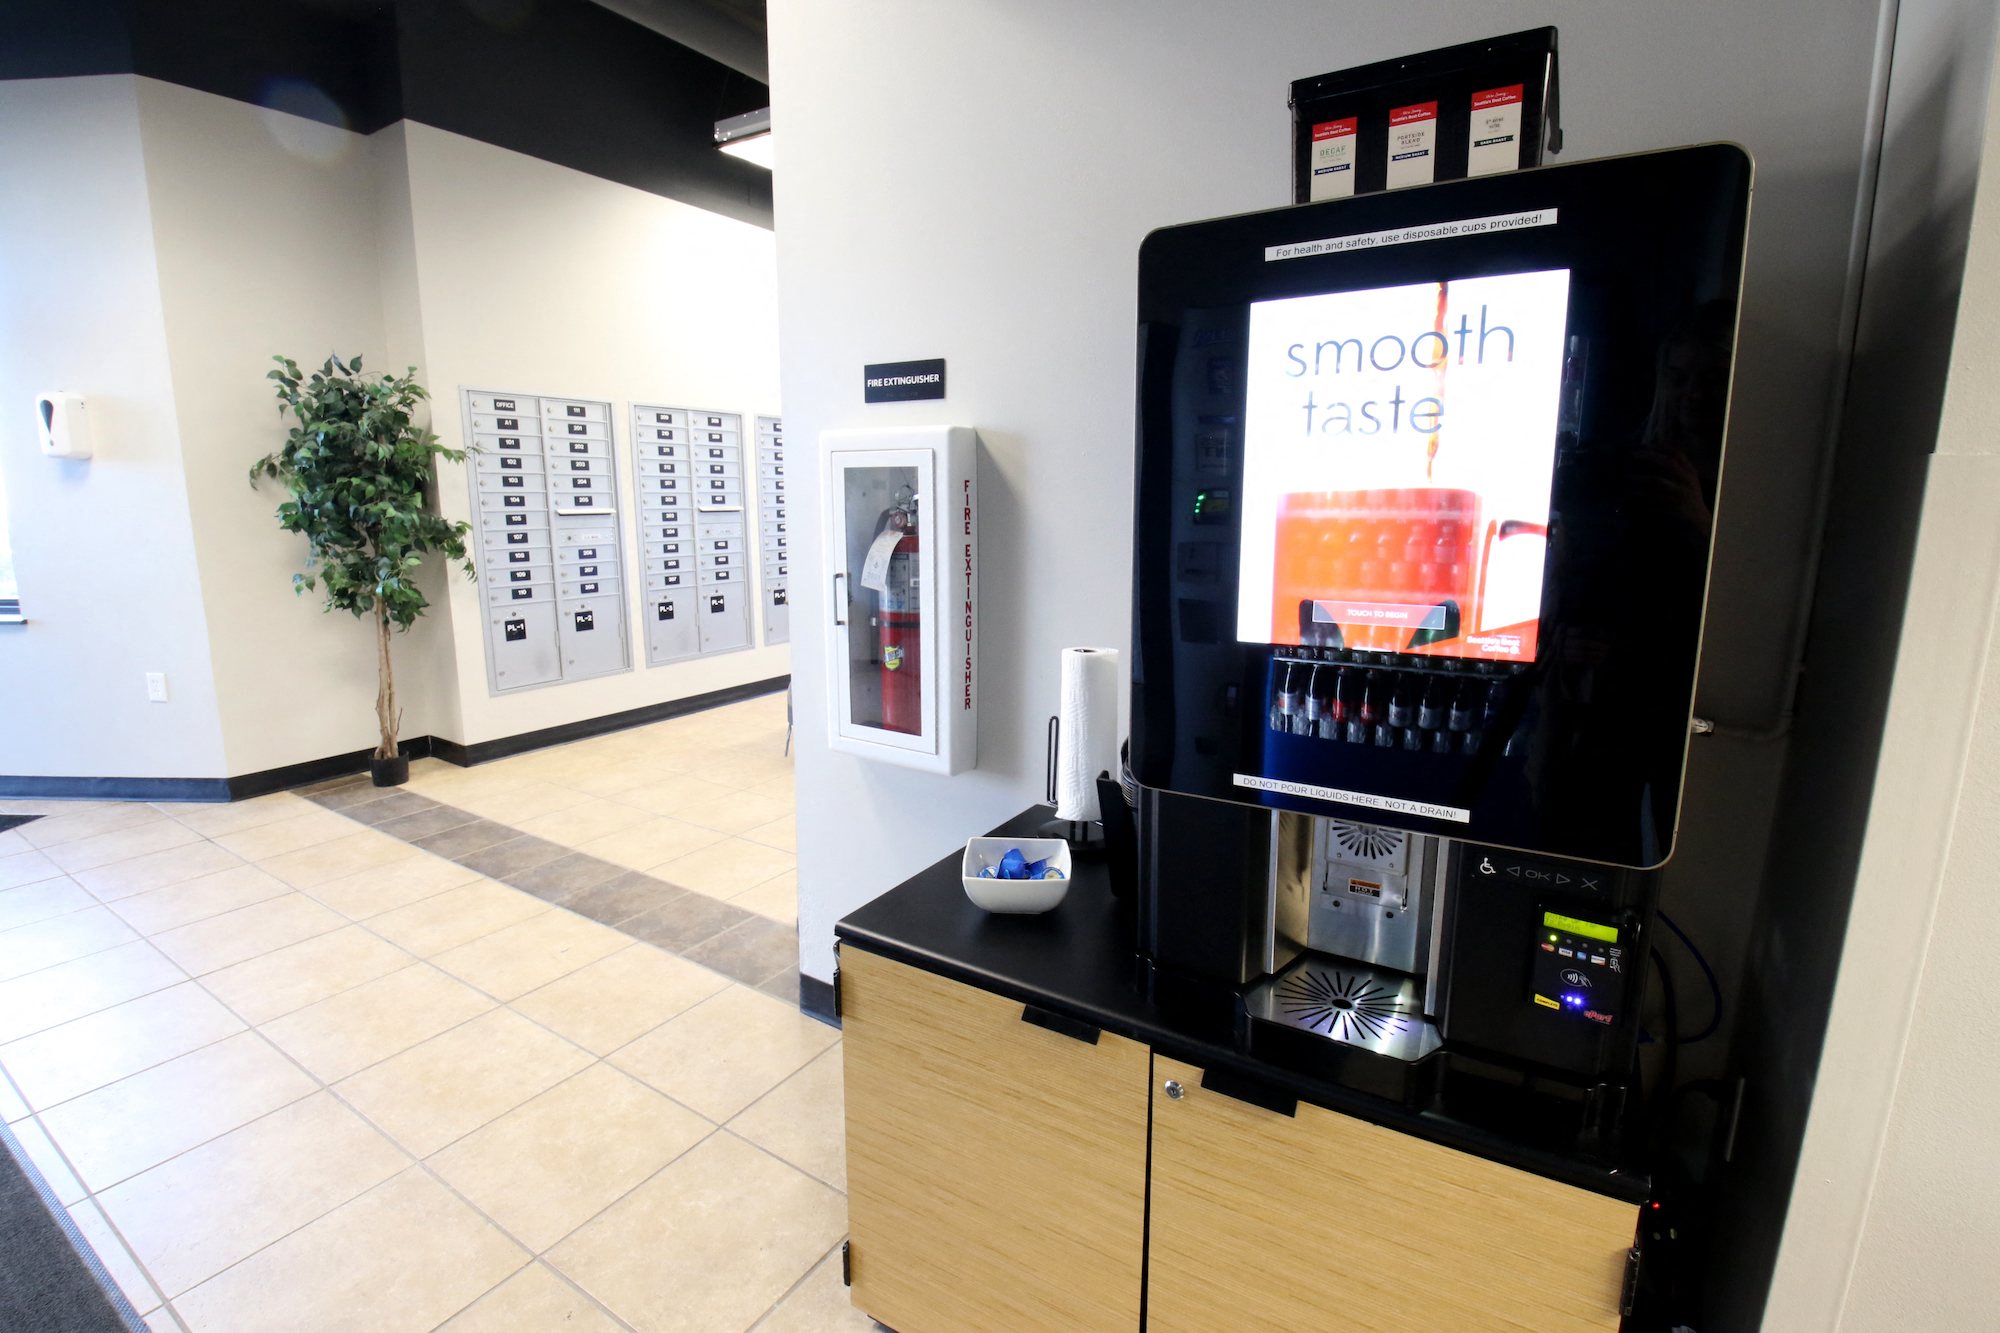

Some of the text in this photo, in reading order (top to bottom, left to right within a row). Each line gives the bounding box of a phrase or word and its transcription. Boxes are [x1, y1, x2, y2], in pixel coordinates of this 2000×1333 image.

[1320, 145, 1346, 156] DECAF
[1276, 248, 1291, 257] For
[1294, 243, 1322, 255] health
[1325, 240, 1343, 251] and
[1381, 234, 1400, 243] use
[1402, 224, 1458, 242] disposable
[1461, 221, 1487, 235] cups
[1490, 214, 1542, 232] provided!
[1285, 304, 1515, 378] smooth
[867, 374, 940, 387] FIRE EXTINGUISHER
[1302, 385, 1445, 437] taste
[576, 614, 593, 623] PL-2
[506, 624, 525, 632] PL-1
[1243, 777, 1257, 787] DO
[1259, 779, 1278, 790] NOT
[1280, 783, 1308, 795] POUR
[1310, 788, 1349, 801] LIQUIDS
[1385, 800, 1407, 810] NOT
[1420, 806, 1456, 818] DRAIN!
[1524, 869, 1550, 881] OK
